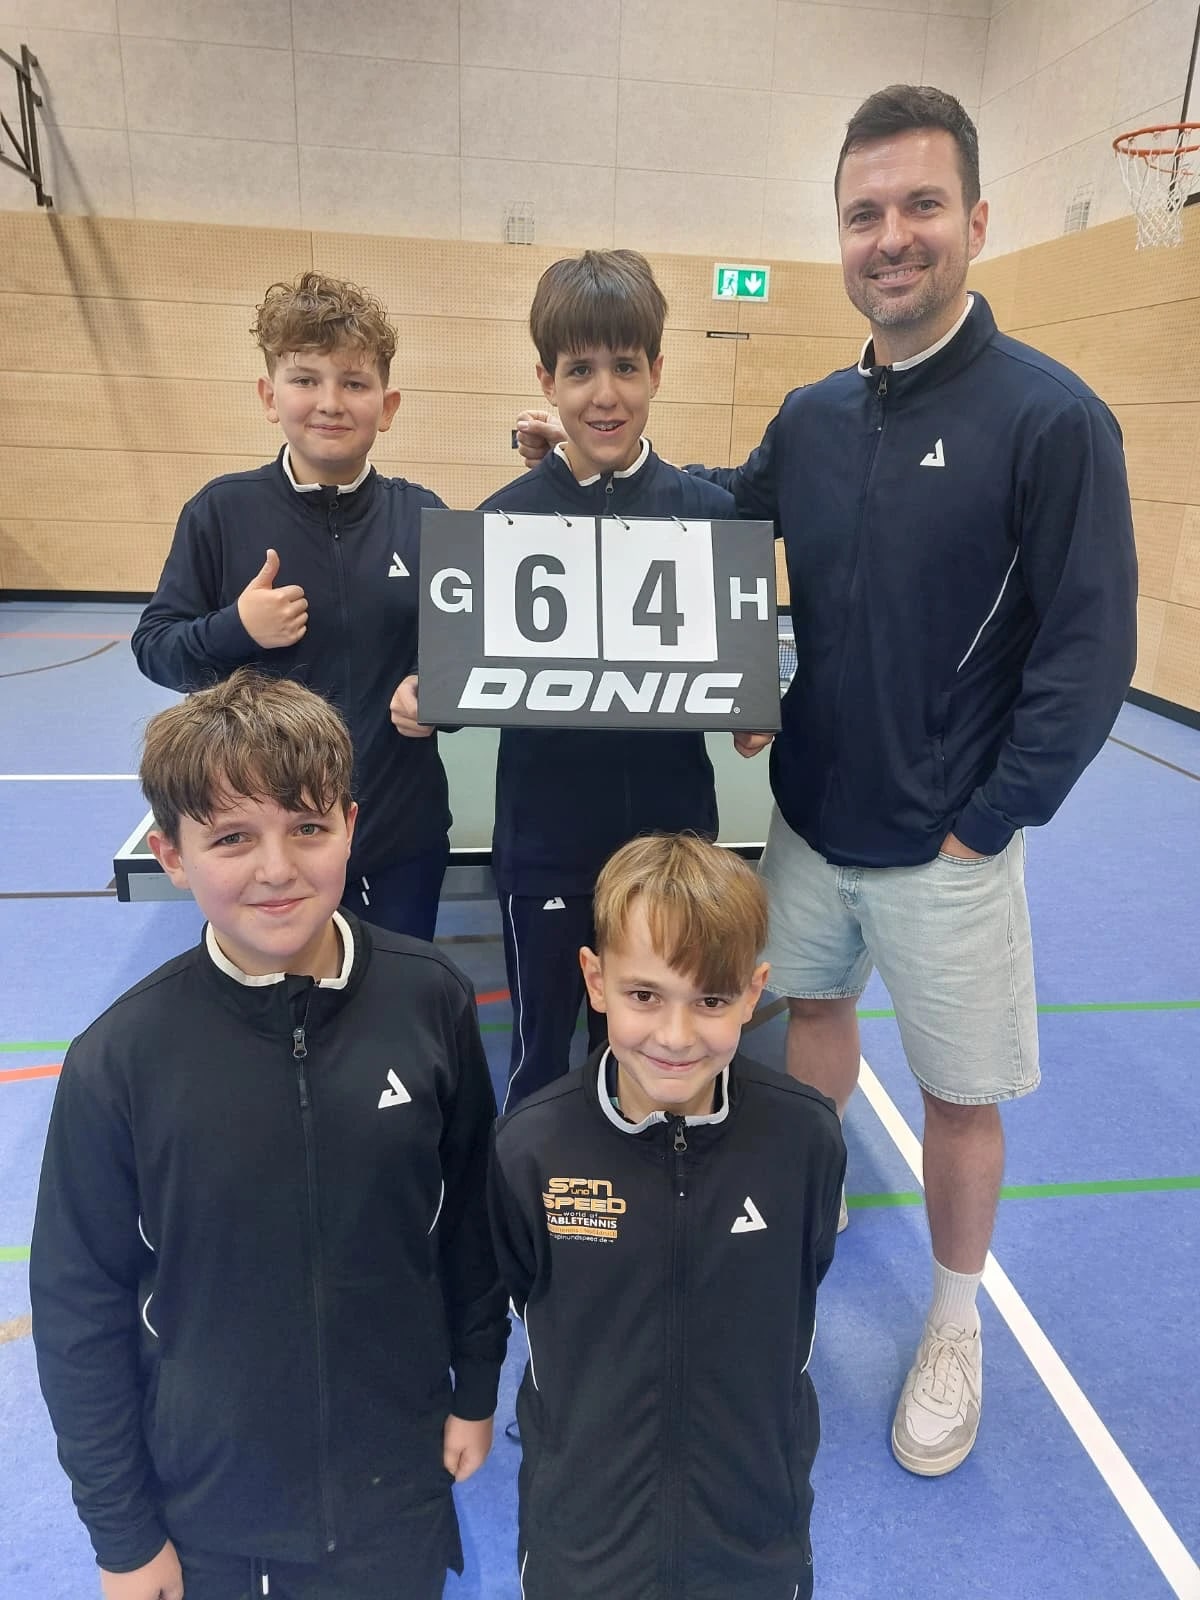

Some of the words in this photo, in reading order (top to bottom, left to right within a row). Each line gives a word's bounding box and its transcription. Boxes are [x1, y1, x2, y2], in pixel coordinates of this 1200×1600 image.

[429, 567, 473, 613] G
[514, 553, 568, 643] 6
[632, 559, 685, 646] 4
[729, 576, 769, 621] H
[457, 666, 743, 714] DONIC
[542, 1191, 627, 1214] SPEED
[546, 1214, 617, 1229] TABLETENNIS
